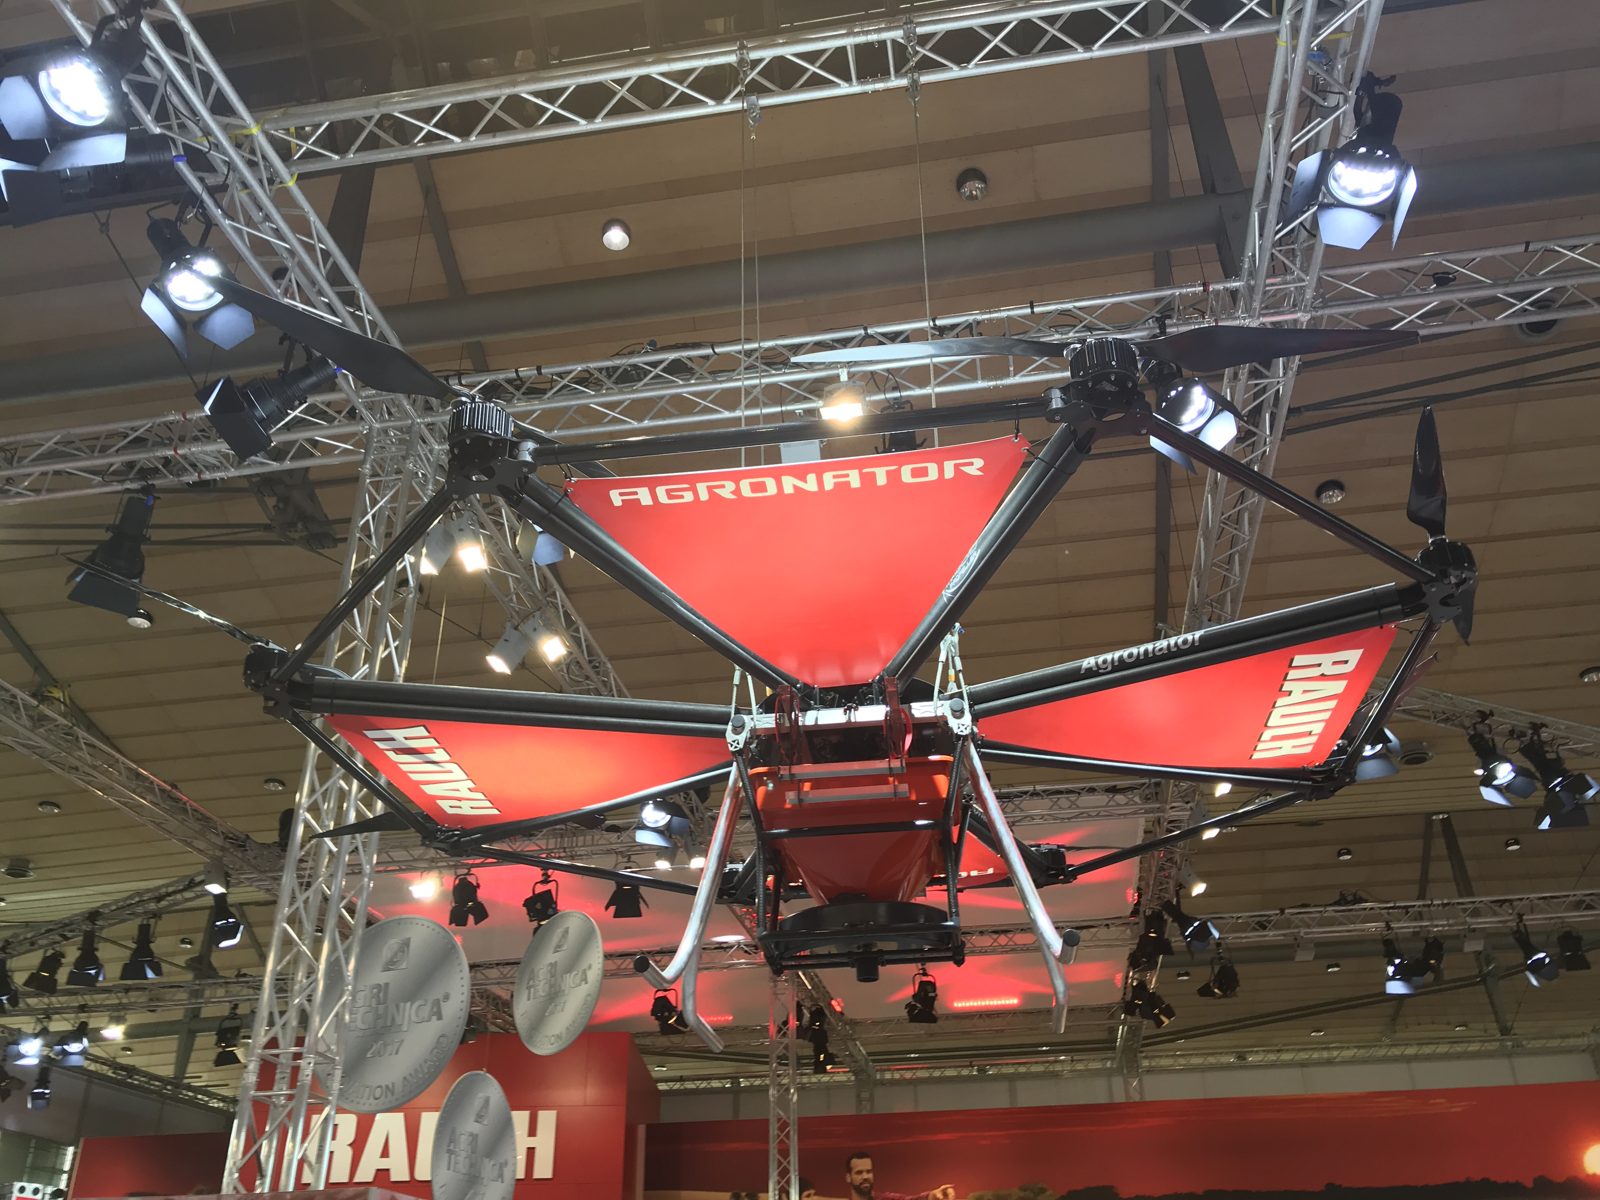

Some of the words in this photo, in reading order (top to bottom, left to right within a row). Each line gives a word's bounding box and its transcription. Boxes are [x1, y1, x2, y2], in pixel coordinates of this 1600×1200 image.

[609, 457, 985, 507] AGRONATOR
[1080, 630, 1204, 673] Agronator
[1251, 649, 1364, 760] RAUCH
[362, 725, 502, 816] RAUCH
[301, 1110, 558, 1184] RAH
